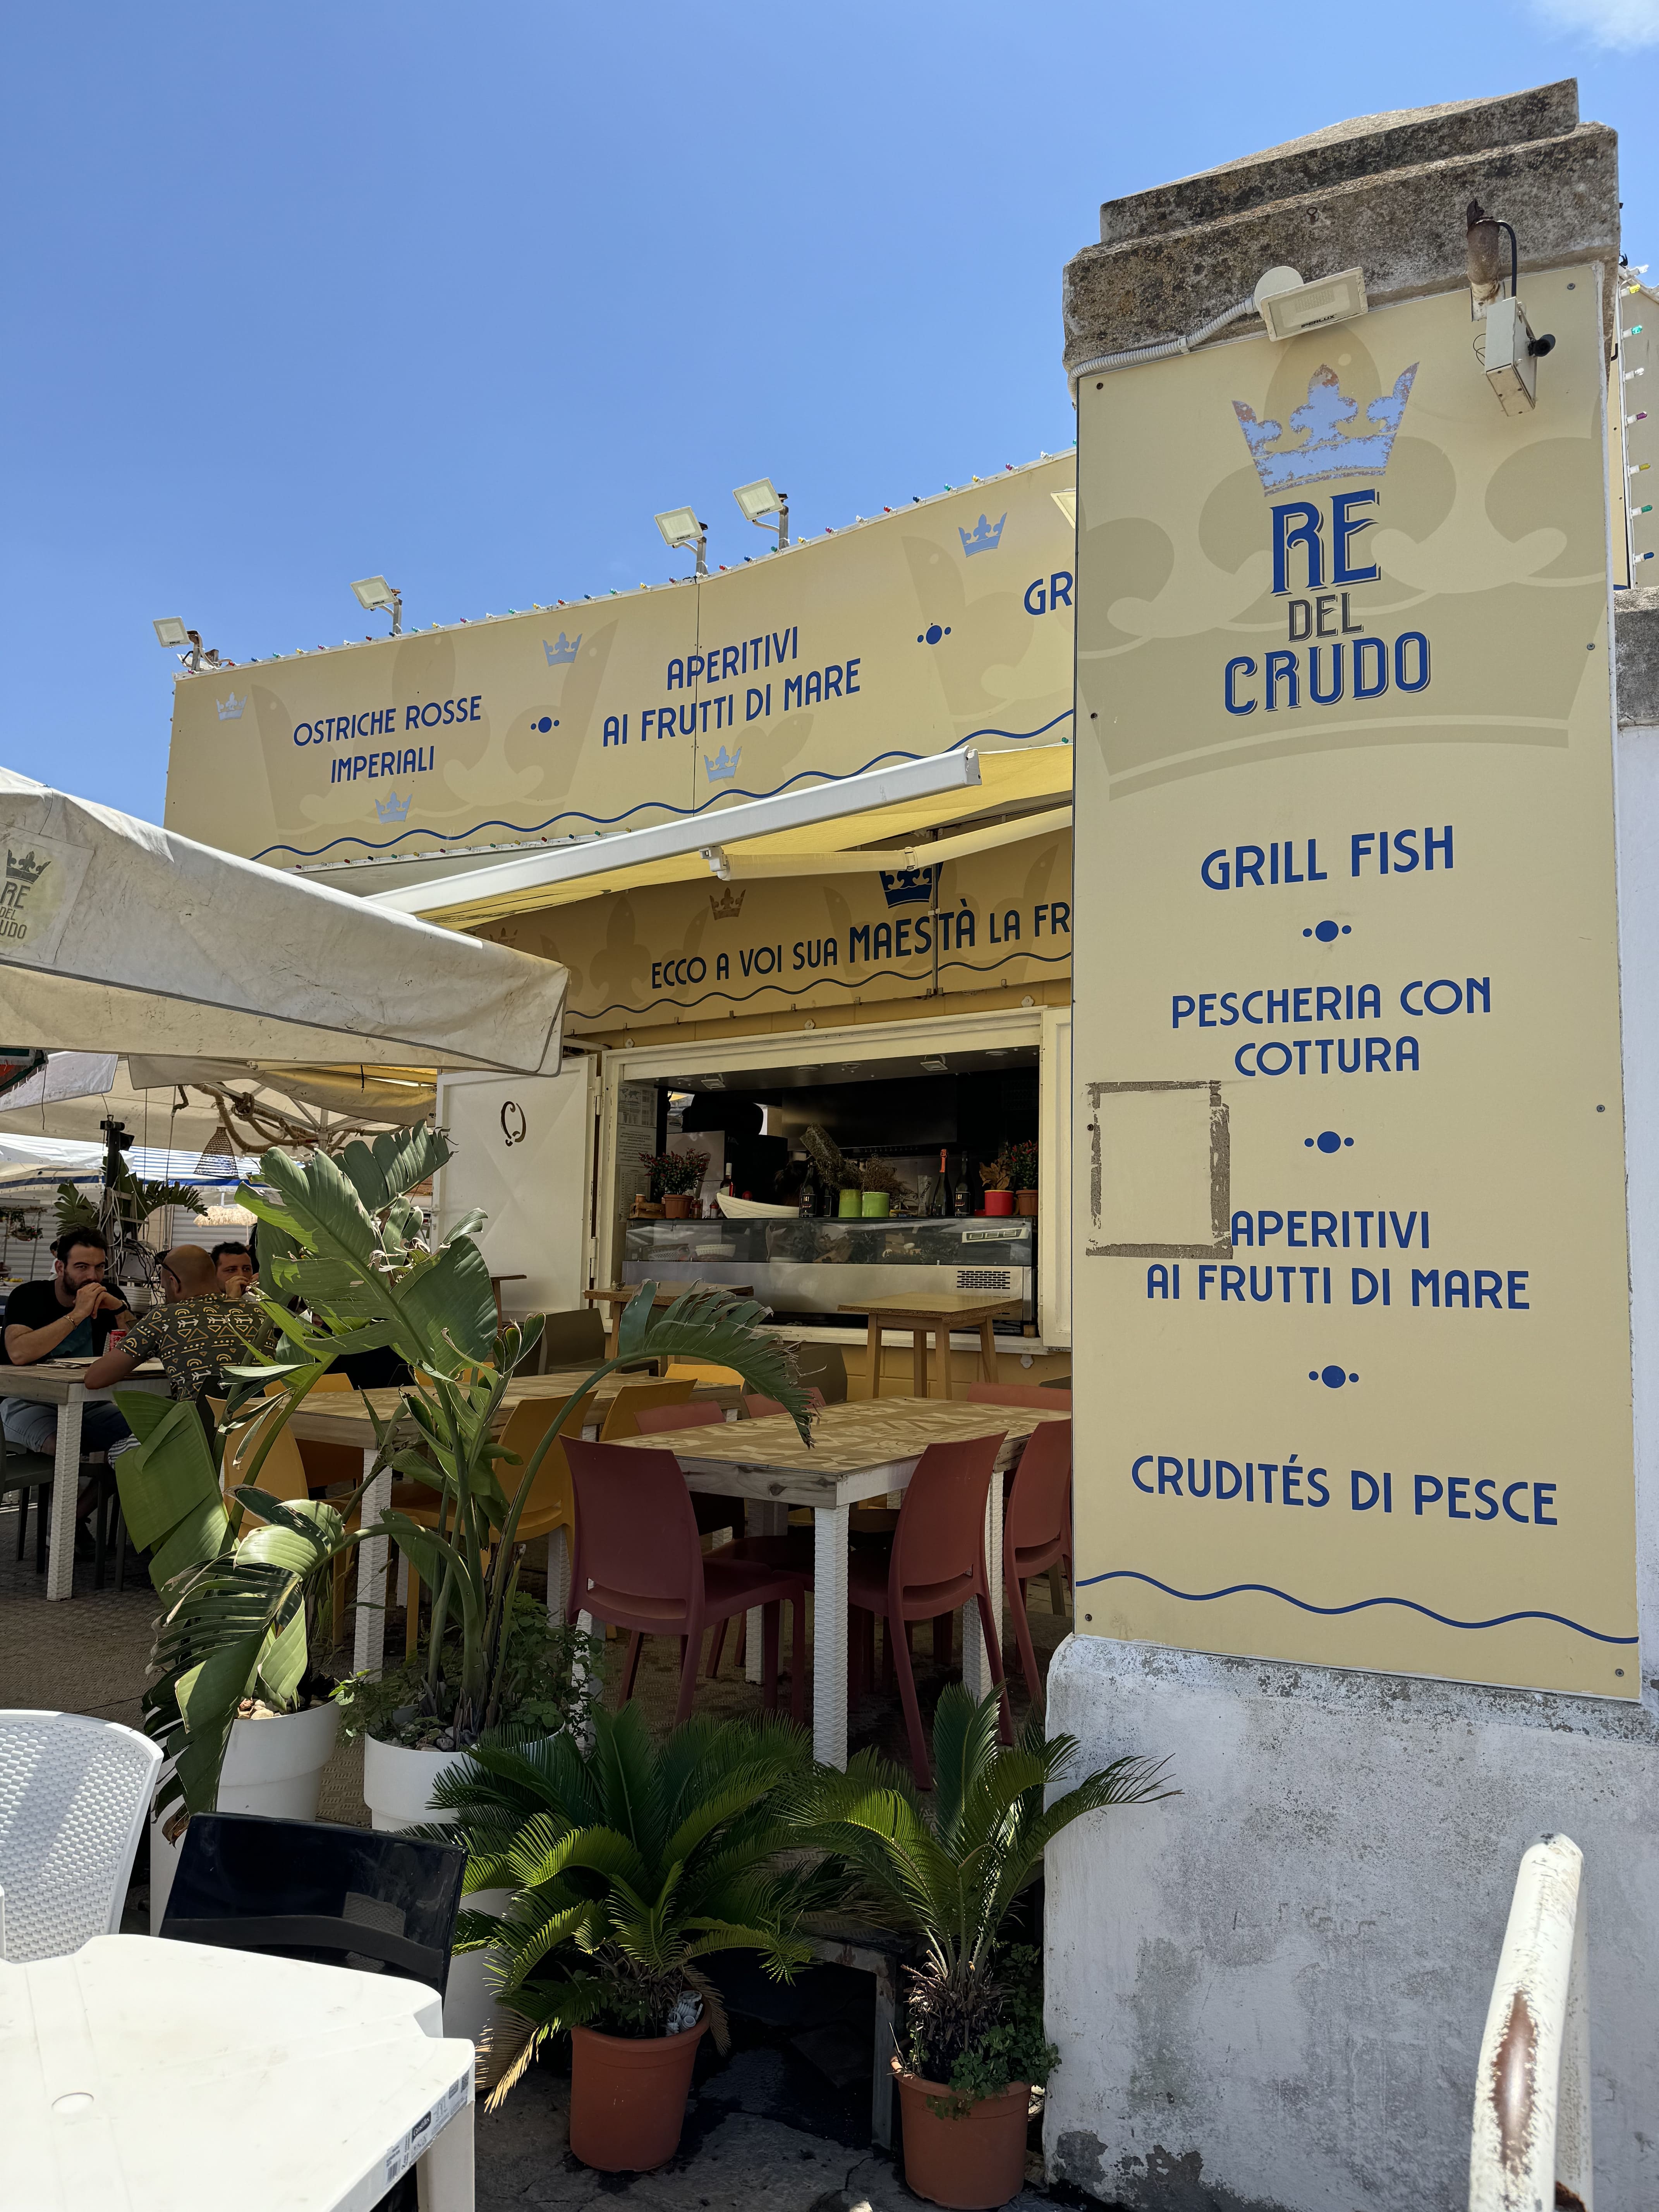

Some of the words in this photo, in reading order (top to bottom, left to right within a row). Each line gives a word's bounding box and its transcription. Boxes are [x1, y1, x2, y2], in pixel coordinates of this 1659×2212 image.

[1269, 489, 1381, 597] RE
[1024, 572, 1073, 615] GR
[1288, 592, 1364, 642] DEL
[668, 627, 797, 690] APERITIVI
[1225, 632, 1431, 716] CRUDO
[294, 708, 396, 746] OSTRICHE
[406, 696, 481, 730] ROSSE
[603, 714, 627, 747] AI
[642, 694, 733, 741] FRUTTI
[746, 684, 770, 721] DI
[785, 658, 860, 711] MARE
[331, 746, 434, 783] IMPERIALI
[1202, 839, 1327, 890] GRILL
[1352, 826, 1453, 876] FISH
[0, 881, 31, 910] RE
[0, 907, 15, 921] DEL
[652, 957, 706, 989] ECCO
[717, 953, 728, 980] A
[740, 945, 781, 977] VOI
[793, 938, 837, 970] SUA
[850, 898, 975, 963] MAESTÀ
[990, 910, 1020, 943] LA
[1035, 902, 1070, 937] FR
[1173, 984, 1380, 1028] PESCHERIA
[1400, 977, 1490, 1015] CON
[1235, 1036, 1419, 1076] COTTURA
[1231, 1211, 1429, 1249] APERITIVI
[1148, 1264, 1179, 1299] AI
[1199, 1265, 1331, 1304] FRUTTI
[1352, 1268, 1390, 1305] DI
[1412, 1269, 1529, 1309] MARE
[1132, 1454, 1329, 1507] CRUDITÉS
[1352, 1470, 1391, 1512] DI
[1415, 1475, 1557, 1525] PESCE
